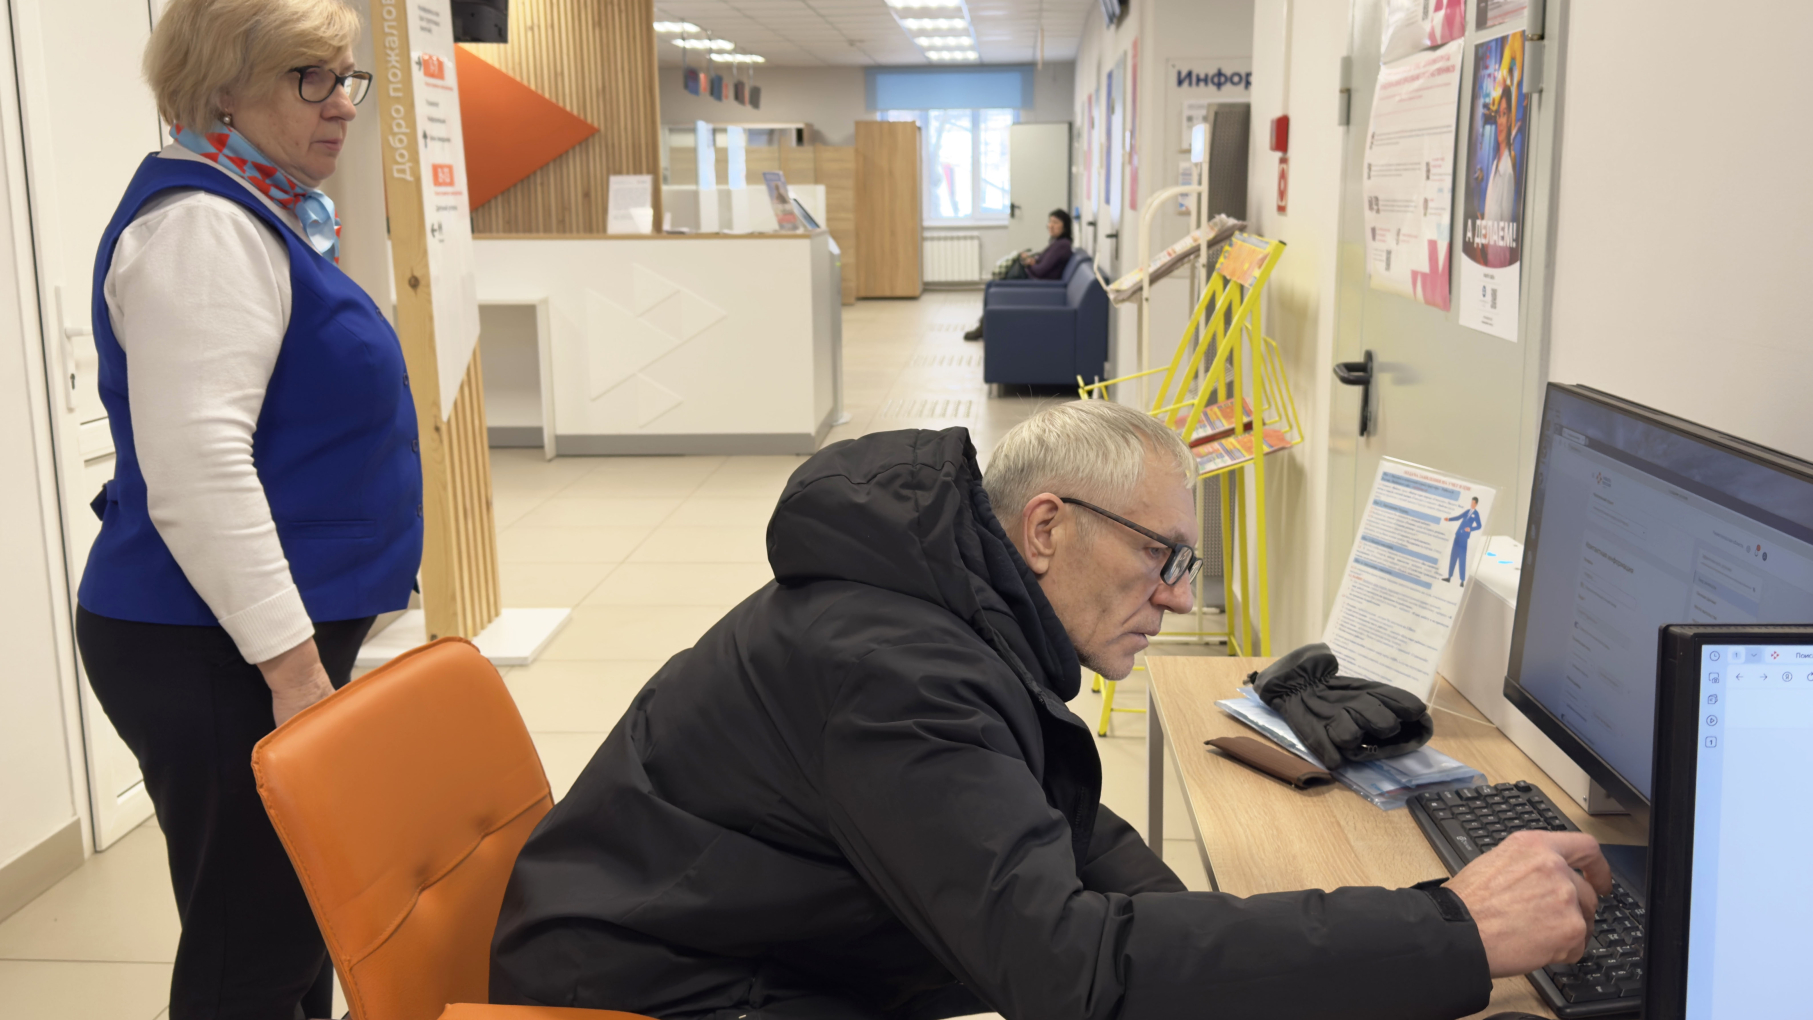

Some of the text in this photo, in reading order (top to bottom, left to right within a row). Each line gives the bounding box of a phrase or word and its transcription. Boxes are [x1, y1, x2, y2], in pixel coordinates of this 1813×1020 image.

[1176, 67, 1252, 91] Инфор
[389, 104, 412, 181] Добро
[1465, 218, 1517, 249] А ДЕЛАЕМ!
